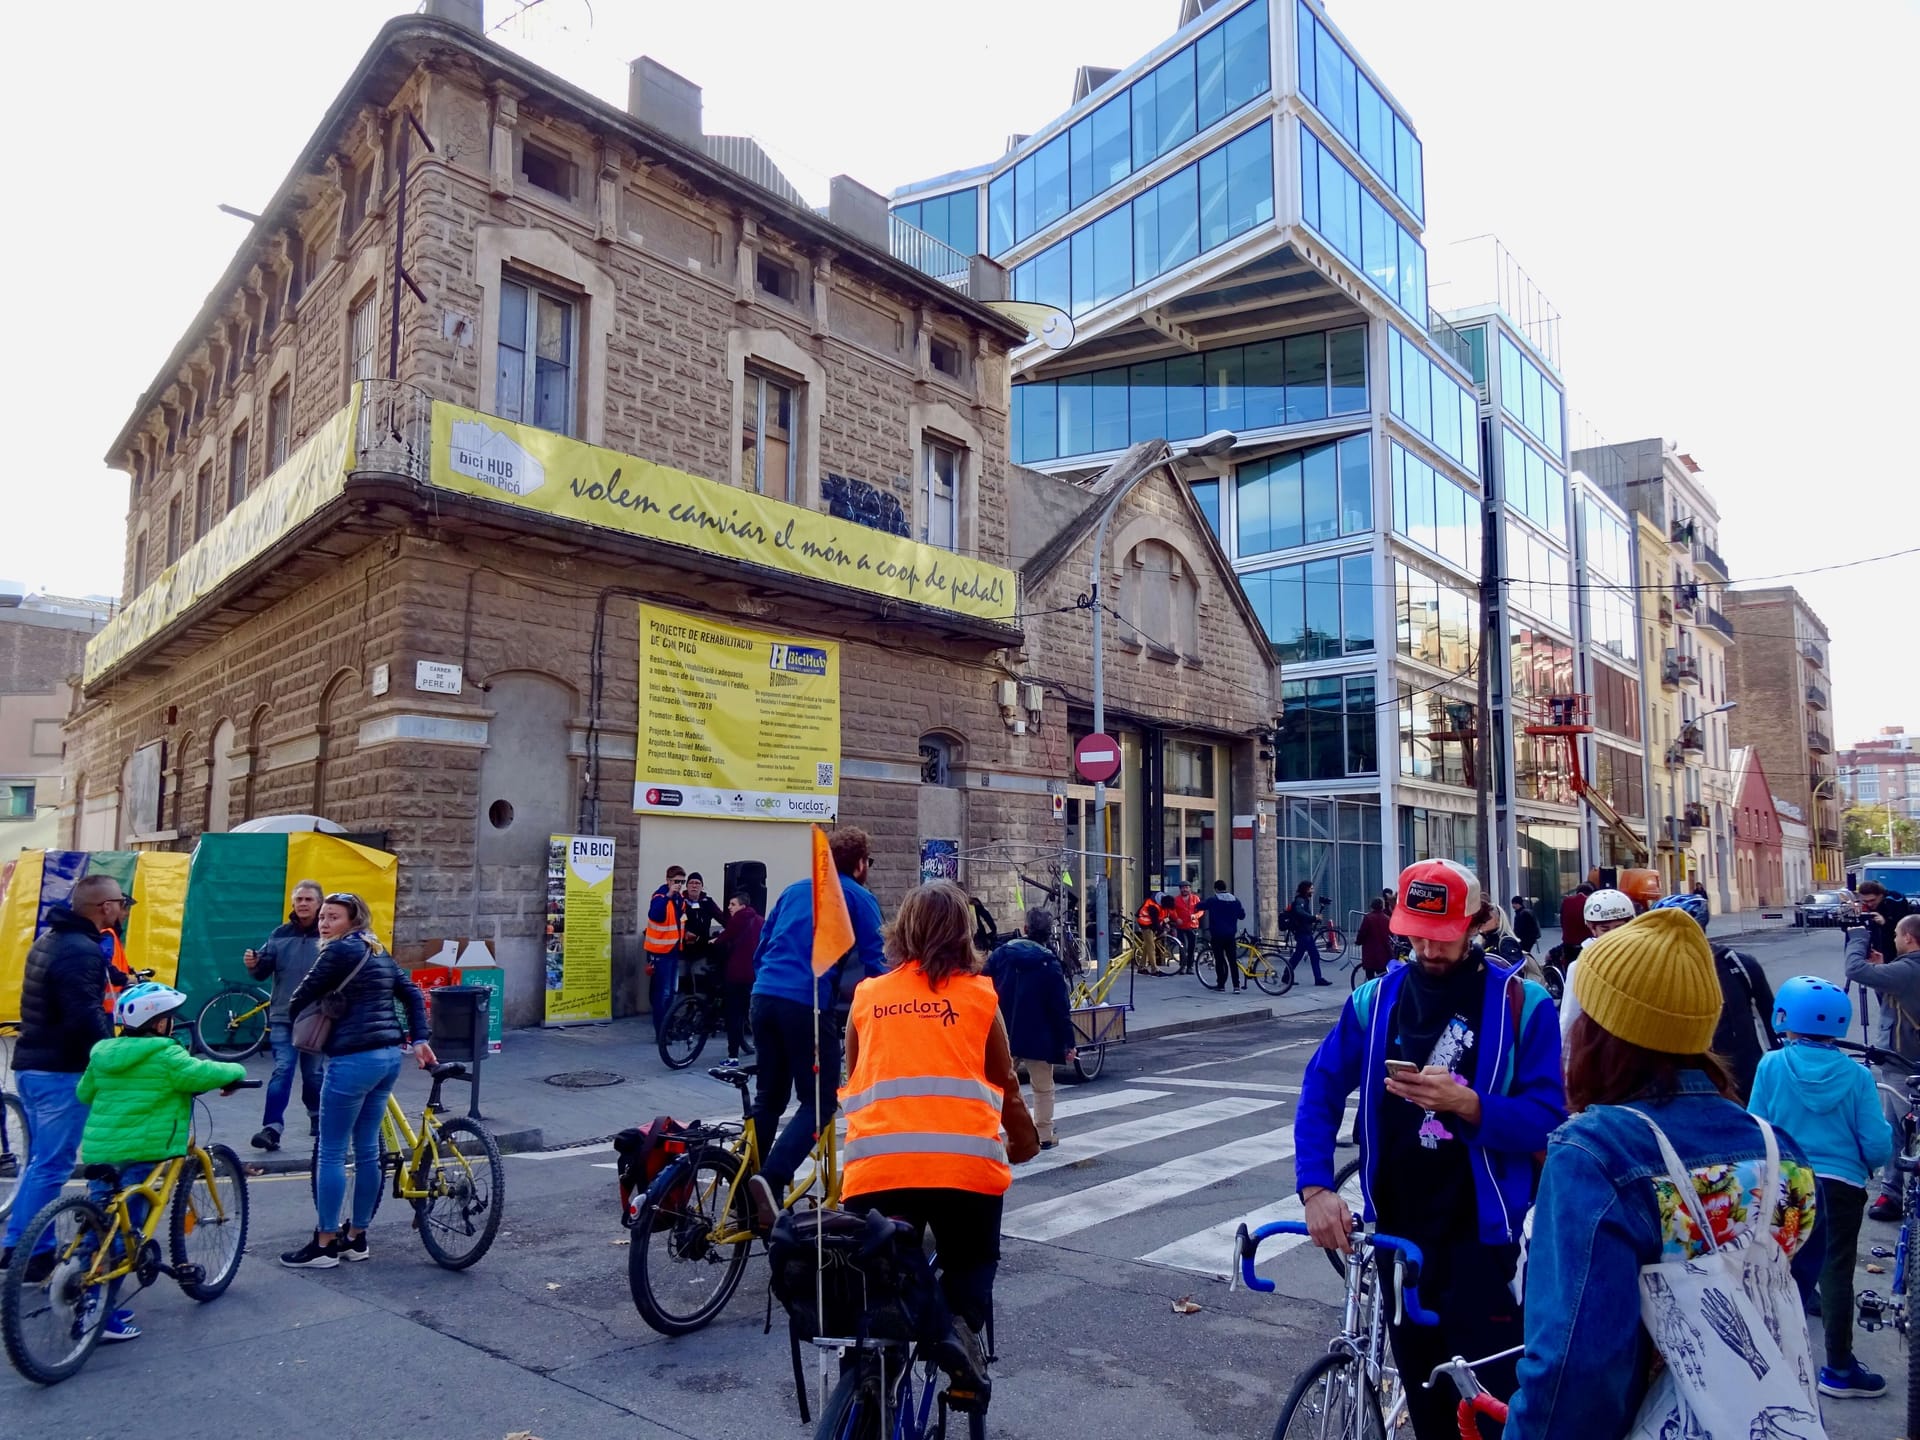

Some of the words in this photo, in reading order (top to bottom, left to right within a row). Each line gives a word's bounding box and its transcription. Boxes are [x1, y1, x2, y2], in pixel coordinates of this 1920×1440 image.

[460, 451, 483, 470] bici
[487, 458, 513, 478] HUB
[476, 471, 495, 486] can
[497, 476, 520, 494] Picó
[570, 468, 660, 514] volem
[668, 503, 767, 544] canviar
[774, 518, 795, 550] el
[801, 537, 851, 566] món
[856, 554, 871, 570] a
[876, 560, 920, 594] coop
[925, 561, 947, 590] de
[950, 574, 1004, 606] pedal!
[688, 629, 698, 640] DE
[788, 650, 826, 668] BiciHub
[422, 679, 445, 688] PERE
[788, 799, 824, 811] biciclot
[574, 842, 588, 856] EN
[590, 842, 612, 856] BICI
[1409, 888, 1435, 898] ANSUL
[874, 998, 941, 1019] biciclot
